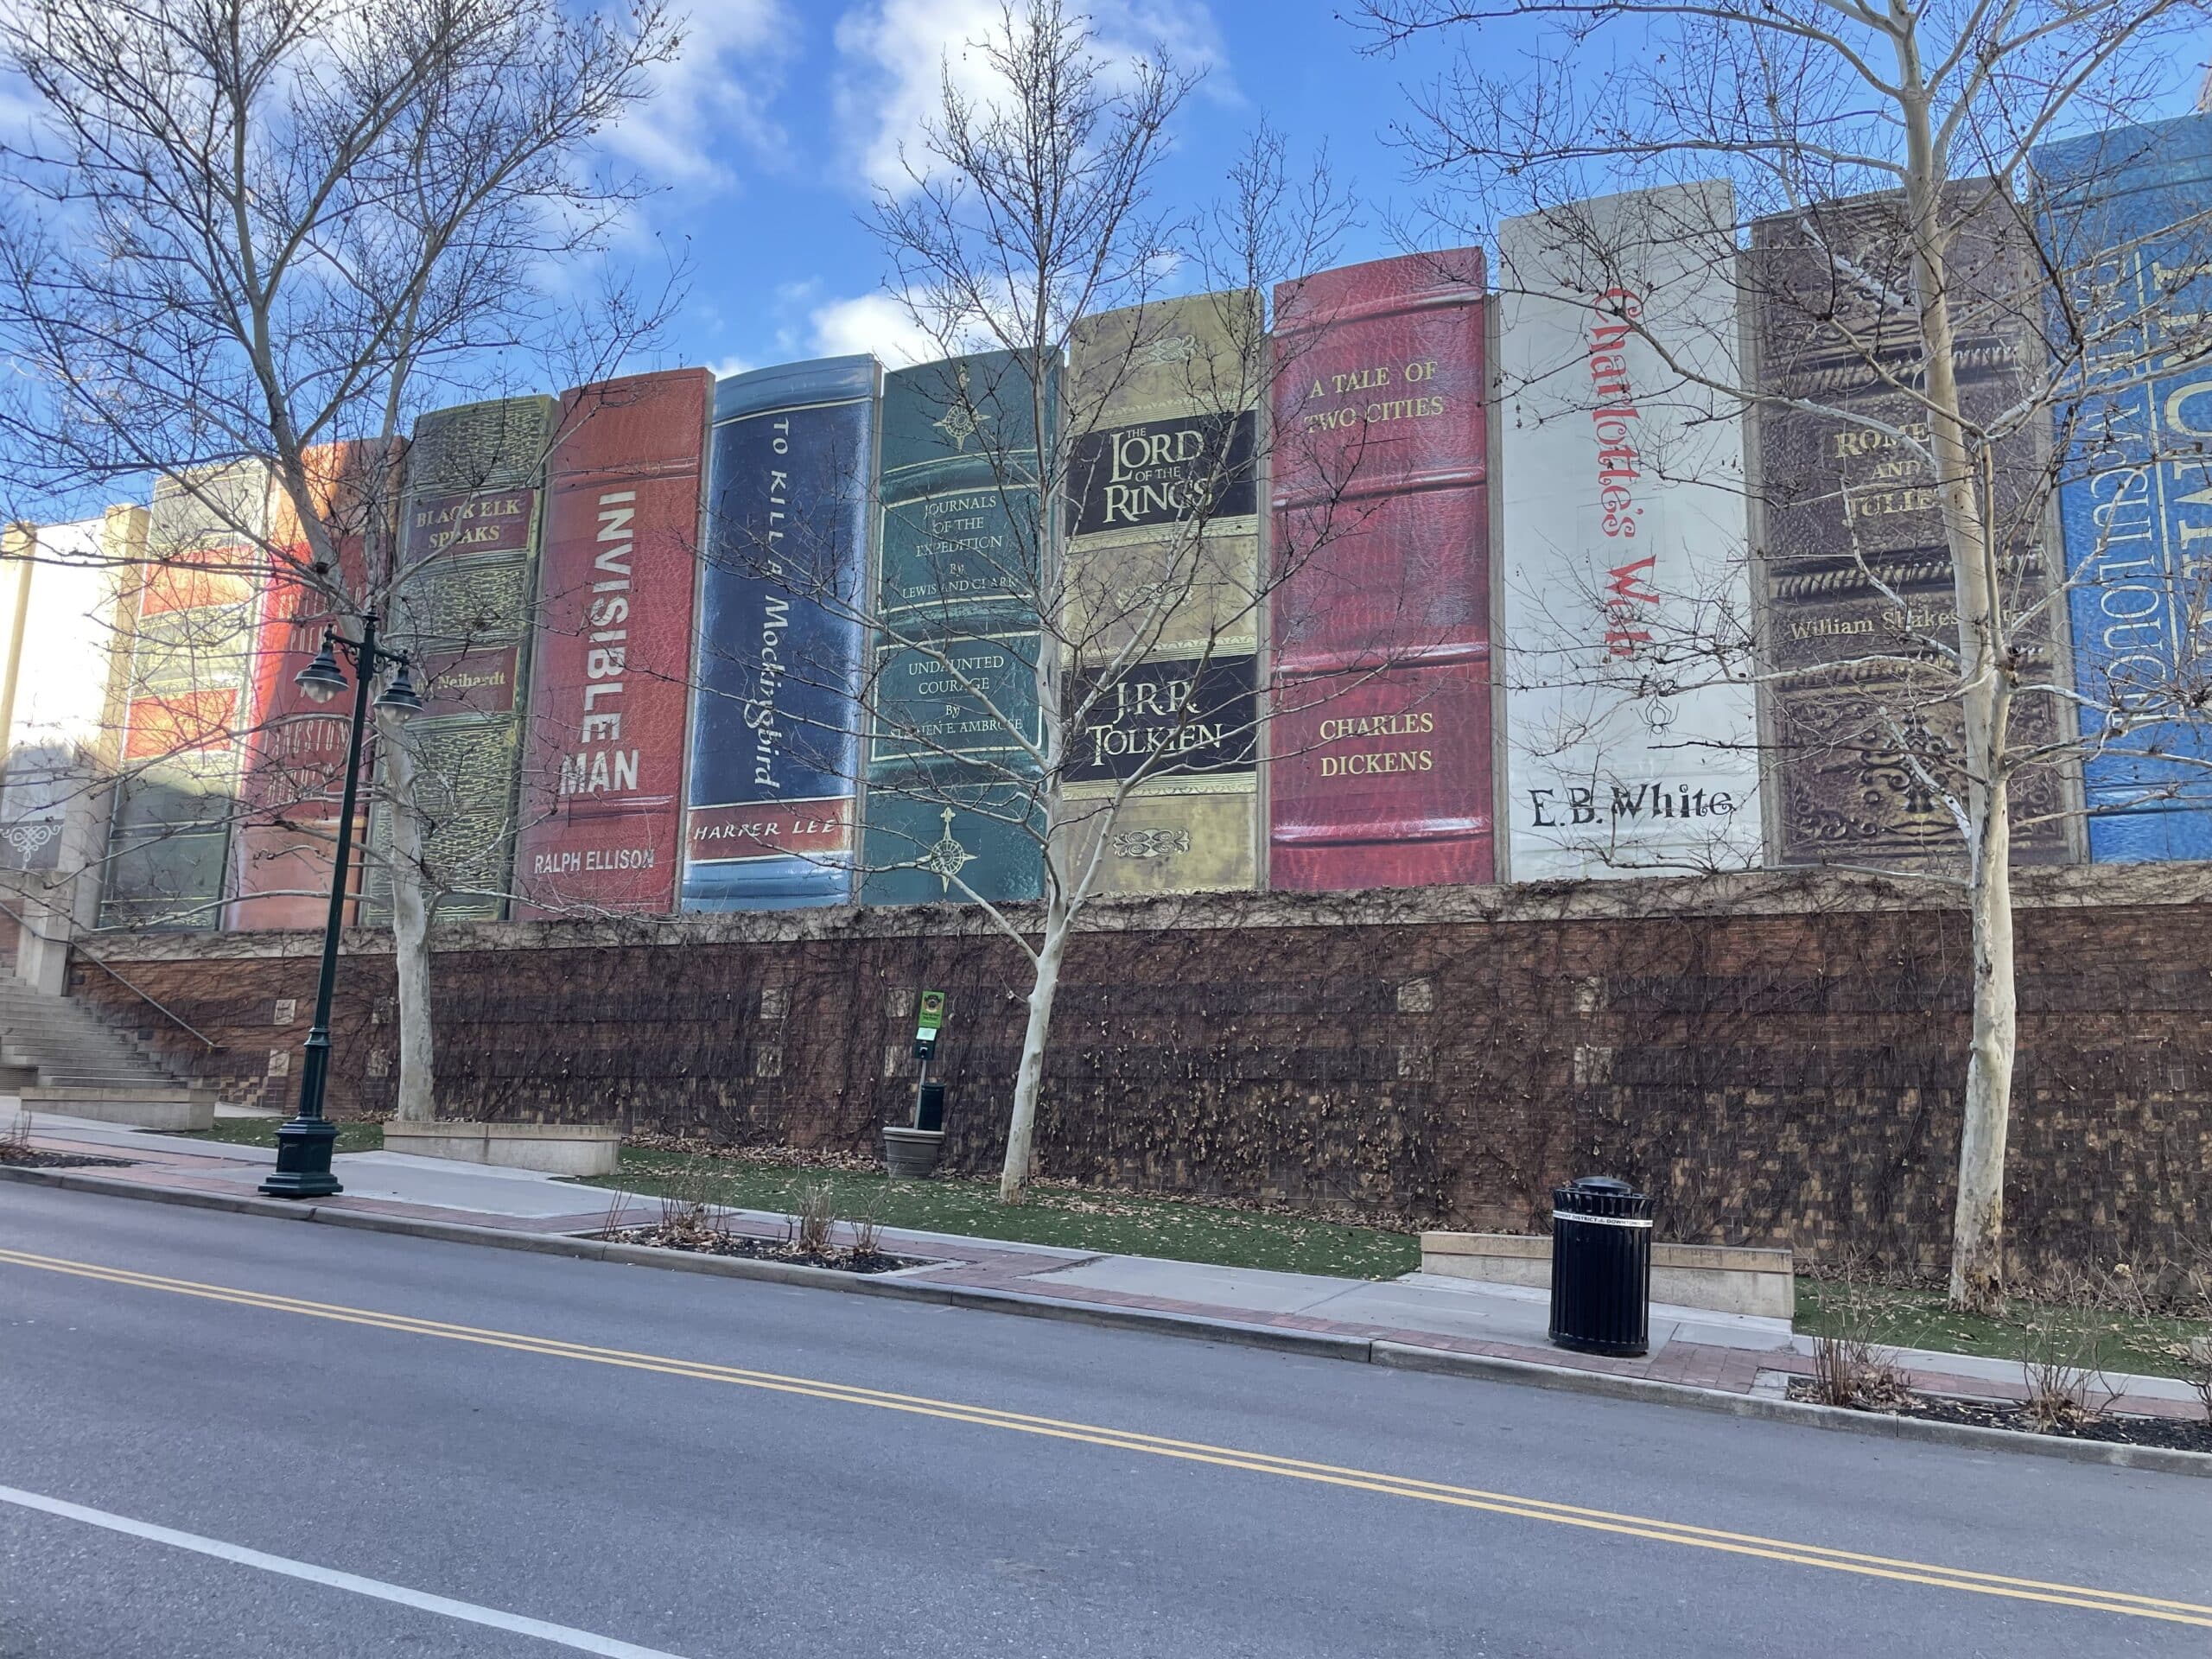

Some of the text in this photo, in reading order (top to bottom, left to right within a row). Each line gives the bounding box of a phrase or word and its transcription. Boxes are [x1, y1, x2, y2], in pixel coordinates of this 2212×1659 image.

[1309, 361, 1439, 398] A TALE OF
[1304, 397, 1444, 434] TWO CITIES
[1588, 288, 1644, 537] Charlotte's
[772, 417, 789, 454] TO
[1126, 428, 1147, 438] THE
[1834, 423, 1931, 458] ROME
[1109, 430, 1205, 483] LORD
[1872, 461, 1921, 480] AND
[1135, 467, 1181, 482] OF THE
[416, 499, 521, 528] BLACK ELK
[768, 470, 787, 547] KILL
[923, 495, 996, 519] JOURNALS
[1103, 478, 1212, 523] RINGS
[1842, 488, 1938, 520] JULIE
[932, 517, 984, 534] OF THE
[915, 536, 1003, 557] EXPEDITION
[903, 583, 937, 599] LEWIS
[941, 580, 969, 593] AND
[581, 491, 636, 743] INVISIBLE
[1605, 554, 1659, 657] Web
[1790, 617, 1874, 640] William
[909, 656, 1004, 675] UNDAUNTED
[437, 671, 505, 690] Neihardt
[744, 594, 790, 789] Mockingbird
[946, 705, 961, 719] By
[1319, 713, 1433, 741] CHARLES
[1089, 723, 1223, 766] TOLKIEN
[560, 749, 639, 796] MAN
[1320, 750, 1433, 777] DICKENS
[1610, 781, 1734, 820] White
[693, 820, 836, 841] HARPER LEE
[533, 849, 655, 874] RALPH ELLISON
